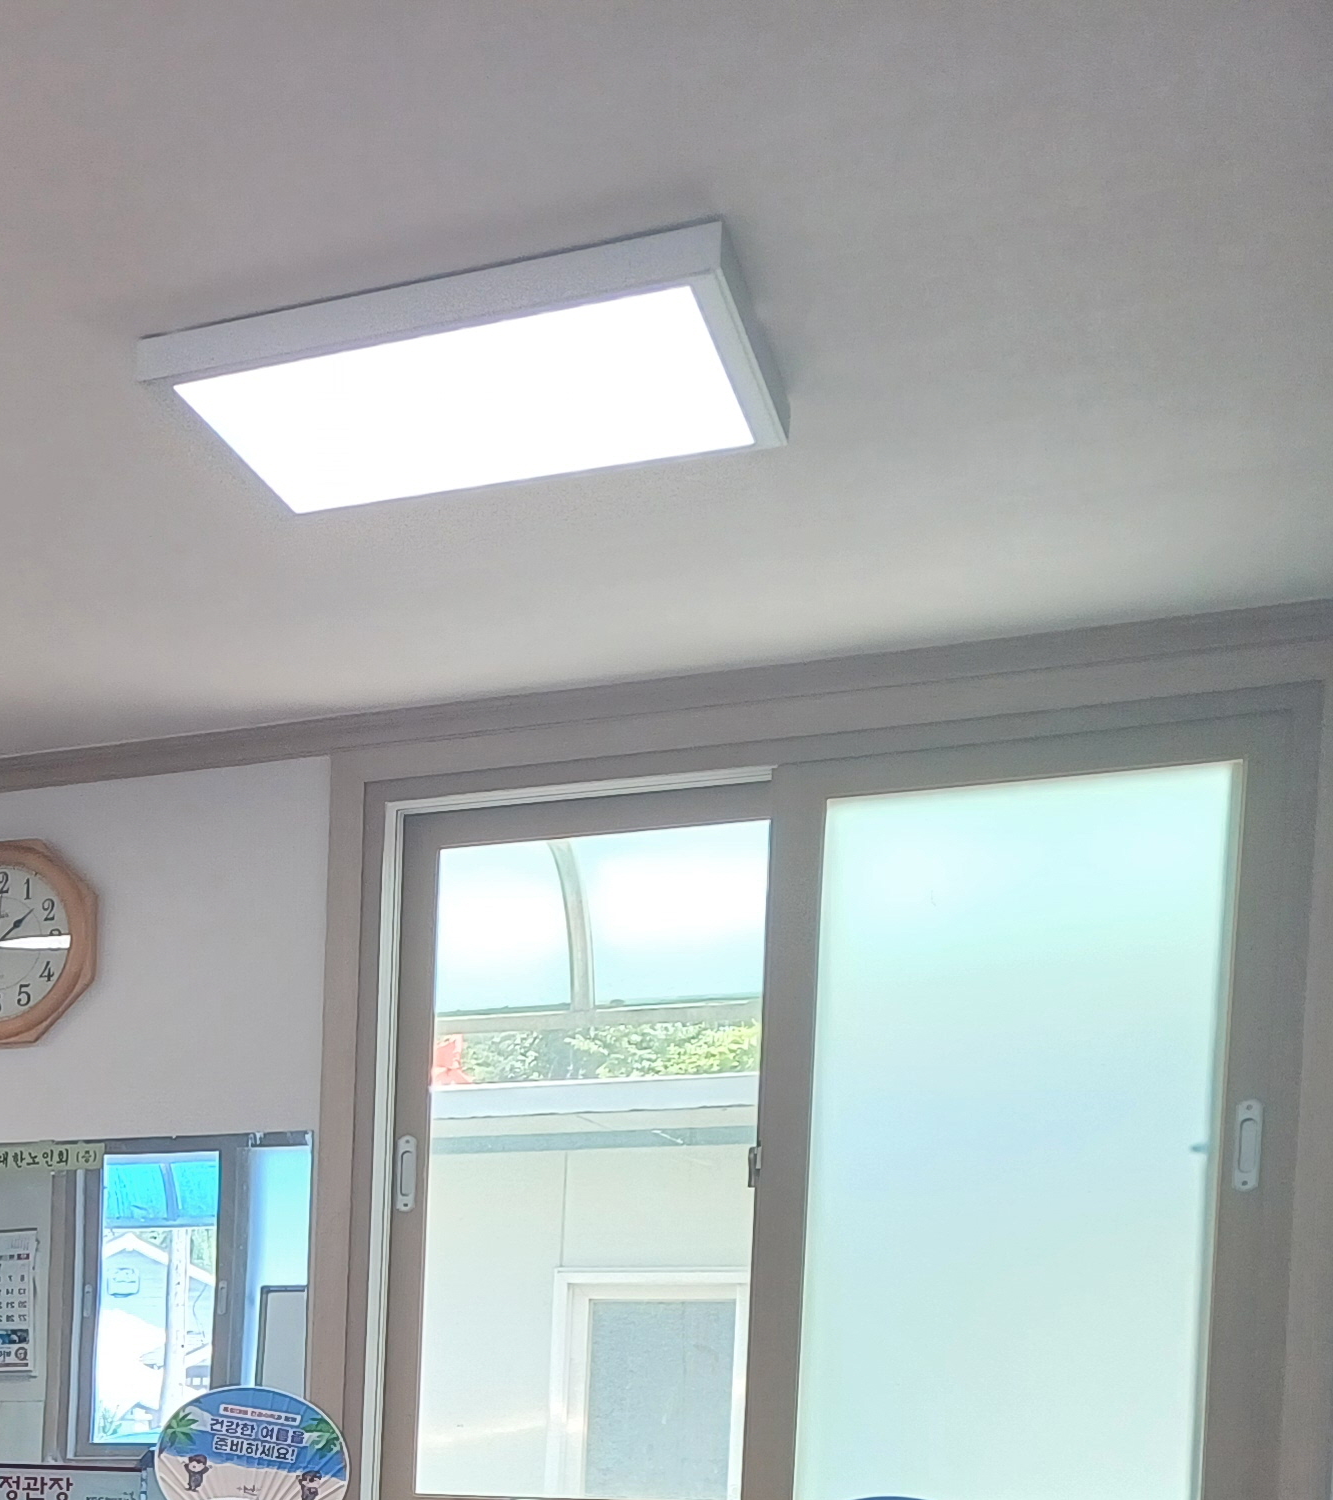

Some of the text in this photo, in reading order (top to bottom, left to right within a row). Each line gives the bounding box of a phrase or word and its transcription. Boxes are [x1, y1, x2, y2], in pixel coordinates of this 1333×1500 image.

[24, 878, 32, 900] 1
[42, 898, 55, 921] 2
[40, 961, 54, 982] 4
[17, 984, 31, 1006] 5
[210, 1418, 304, 1444] 건강한 여름을
[214, 1437, 295, 1461] 준비하세요!
